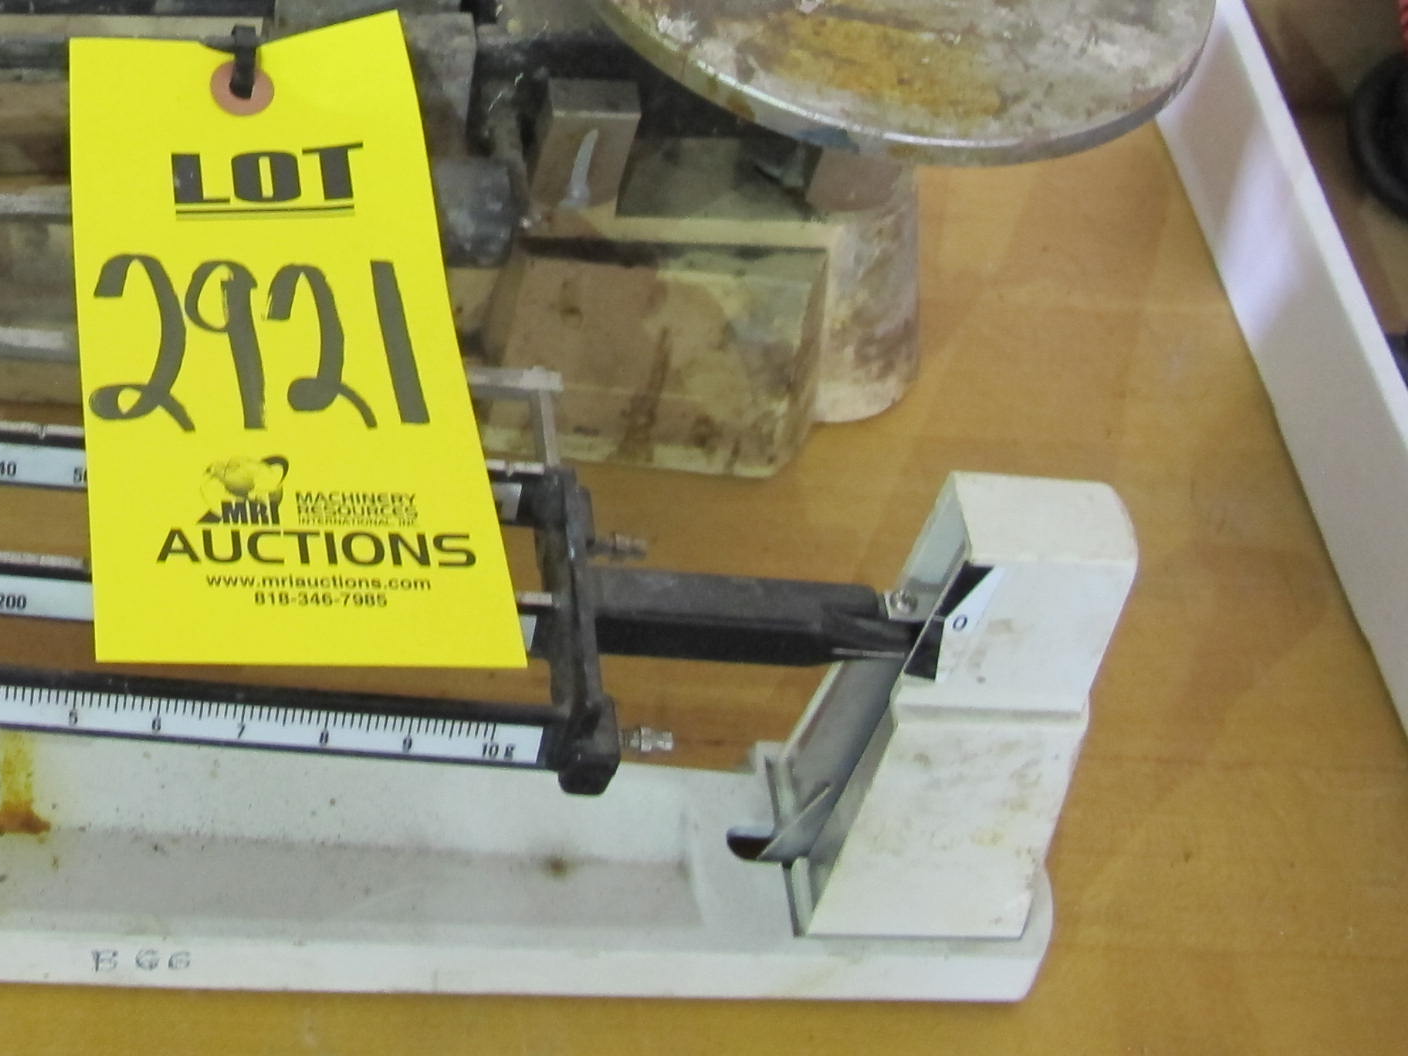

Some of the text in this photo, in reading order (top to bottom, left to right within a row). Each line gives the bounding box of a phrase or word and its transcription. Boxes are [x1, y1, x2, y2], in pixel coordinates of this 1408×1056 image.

[171, 141, 364, 205] LOT
[89, 253, 431, 433] 2921
[73, 466, 87, 483] 5
[295, 491, 416, 505] MACHINERY
[220, 499, 280, 525] MRI
[296, 504, 418, 520] RESOURCES
[156, 528, 476, 567] AUCTIONS
[206, 573, 432, 591] www.mriauctions.com
[255, 591, 388, 608] 818-346-7985
[482, 741, 499, 759] 10
